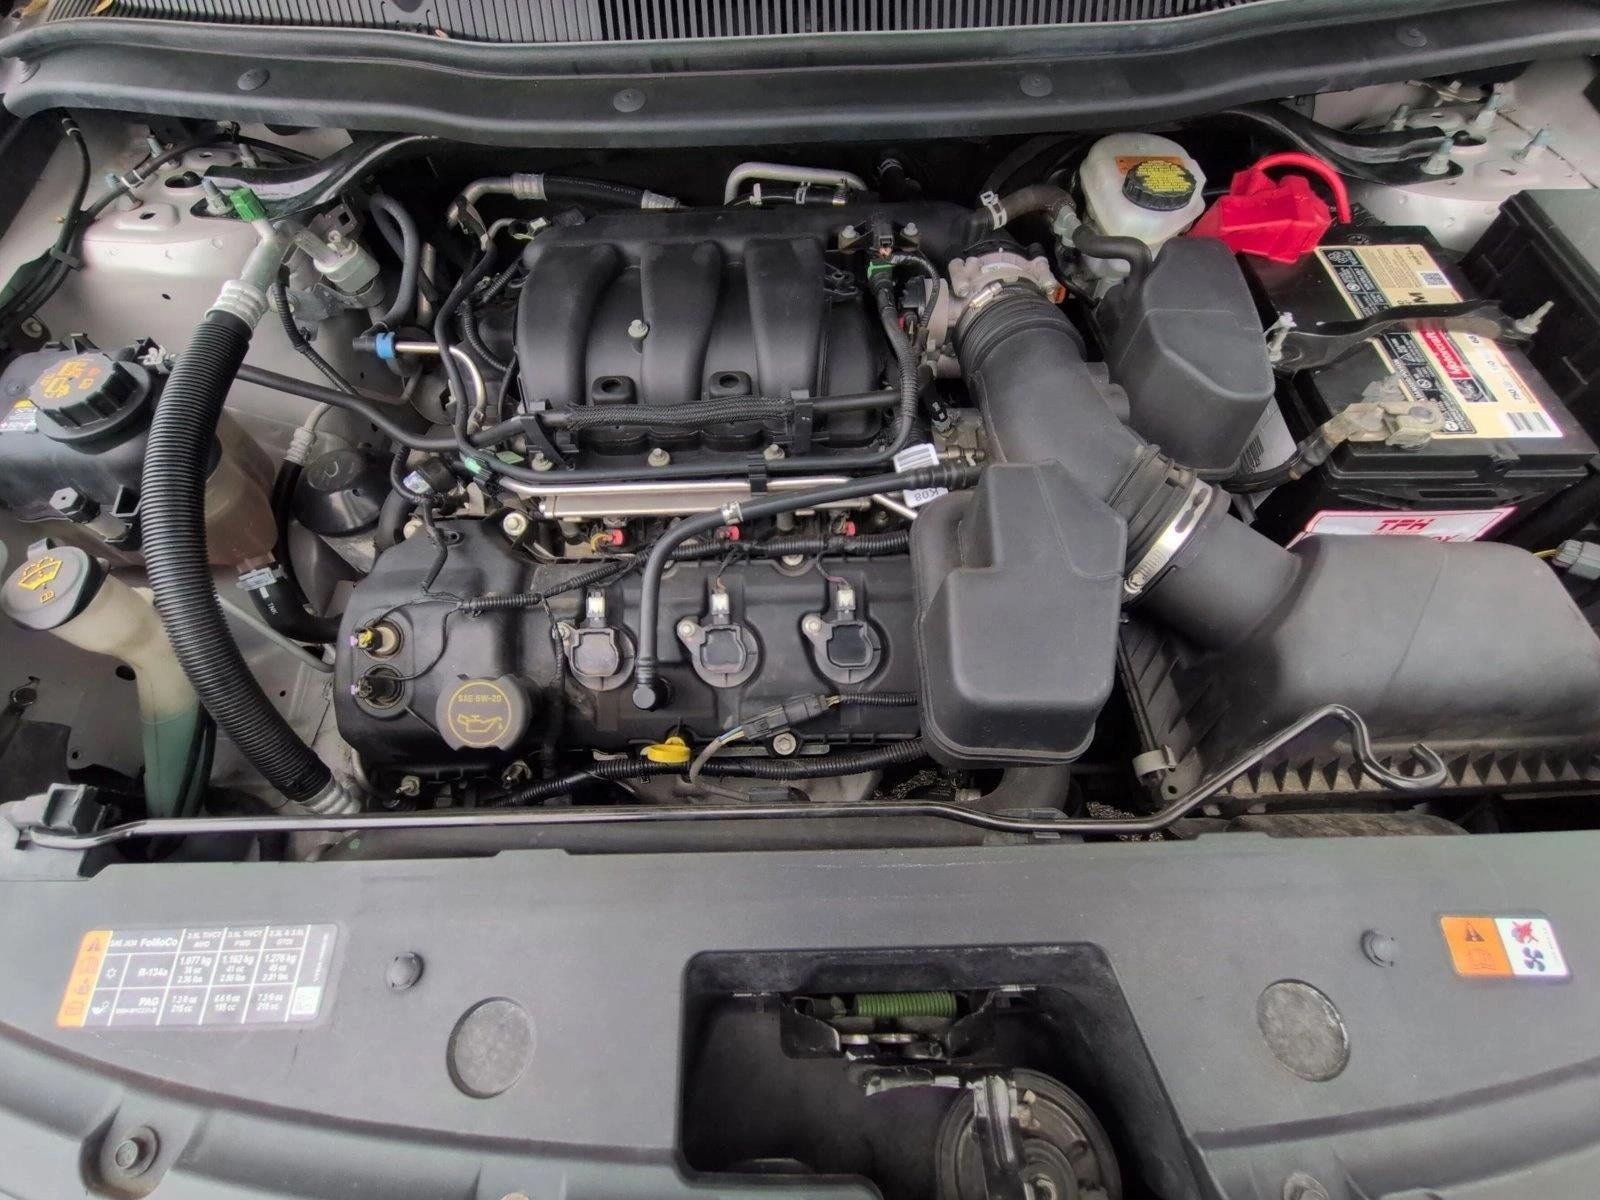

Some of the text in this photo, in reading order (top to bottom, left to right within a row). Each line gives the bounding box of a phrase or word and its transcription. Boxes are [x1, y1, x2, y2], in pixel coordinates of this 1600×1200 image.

[1426, 332, 1463, 374] Motorcraft
[914, 488, 939, 502] K08
[458, 694, 502, 703] SAE 5W-20
[140, 938, 177, 947] FoMoCo
[139, 997, 159, 1006] PAG
